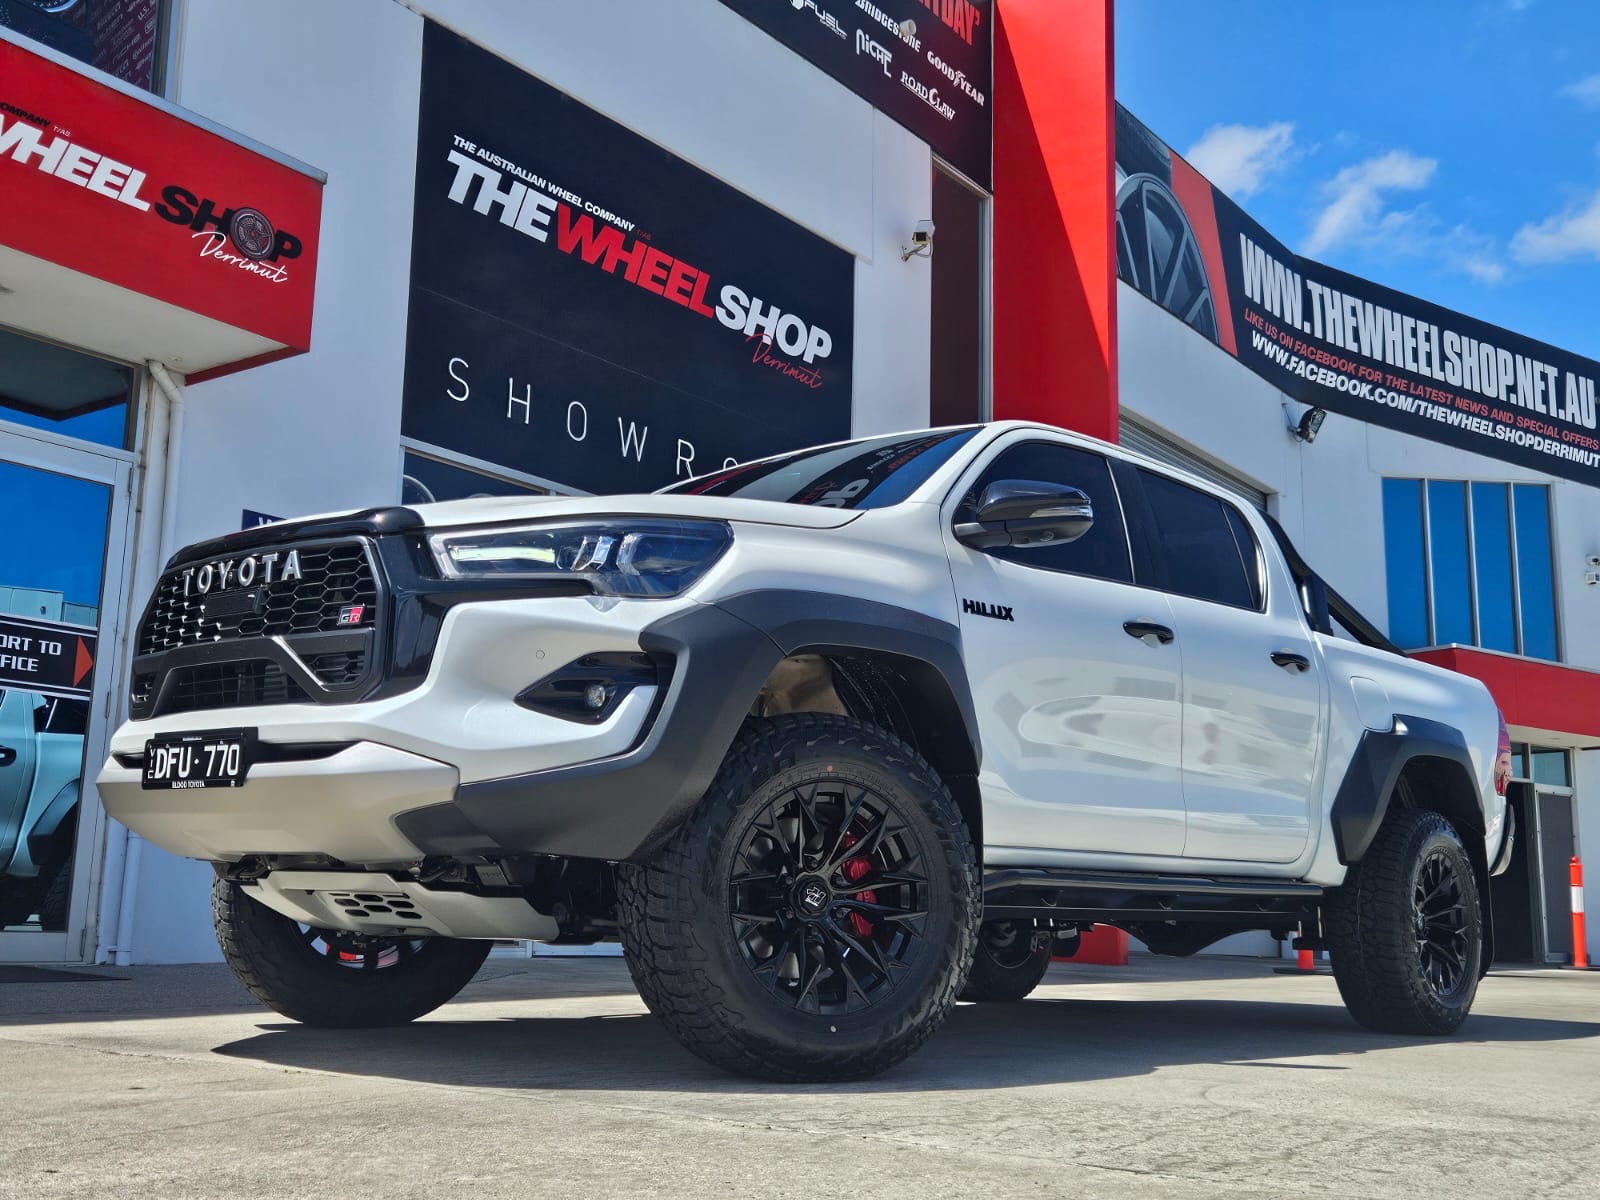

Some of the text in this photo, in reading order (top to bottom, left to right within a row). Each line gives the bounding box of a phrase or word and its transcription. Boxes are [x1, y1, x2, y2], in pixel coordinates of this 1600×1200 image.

[927, 50, 985, 107] GOODYEAR
[0, 102, 51, 128] OMPANY
[453, 134, 477, 154] THE
[477, 148, 547, 189] AUSTRALIAN
[547, 182, 584, 208] WHEEL
[584, 201, 635, 232] COMPANY
[191, 231, 289, 283] Derrimut
[447, 149, 833, 364] THE WHEEL SHOP
[1239, 232, 1598, 431] WWW.THEWHEELSHOP.NET.AU
[745, 332, 823, 389] Derrimut
[1245, 307, 1600, 450] LIKE US ON FACEBOOK FOR THE LATEST NEWS AND SPECIAL OFFERS
[181, 549, 302, 597] TOYOTA
[962, 598, 1015, 622] HILUX
[0, 653, 39, 672] FICE
[38, 639, 62, 656] TO
